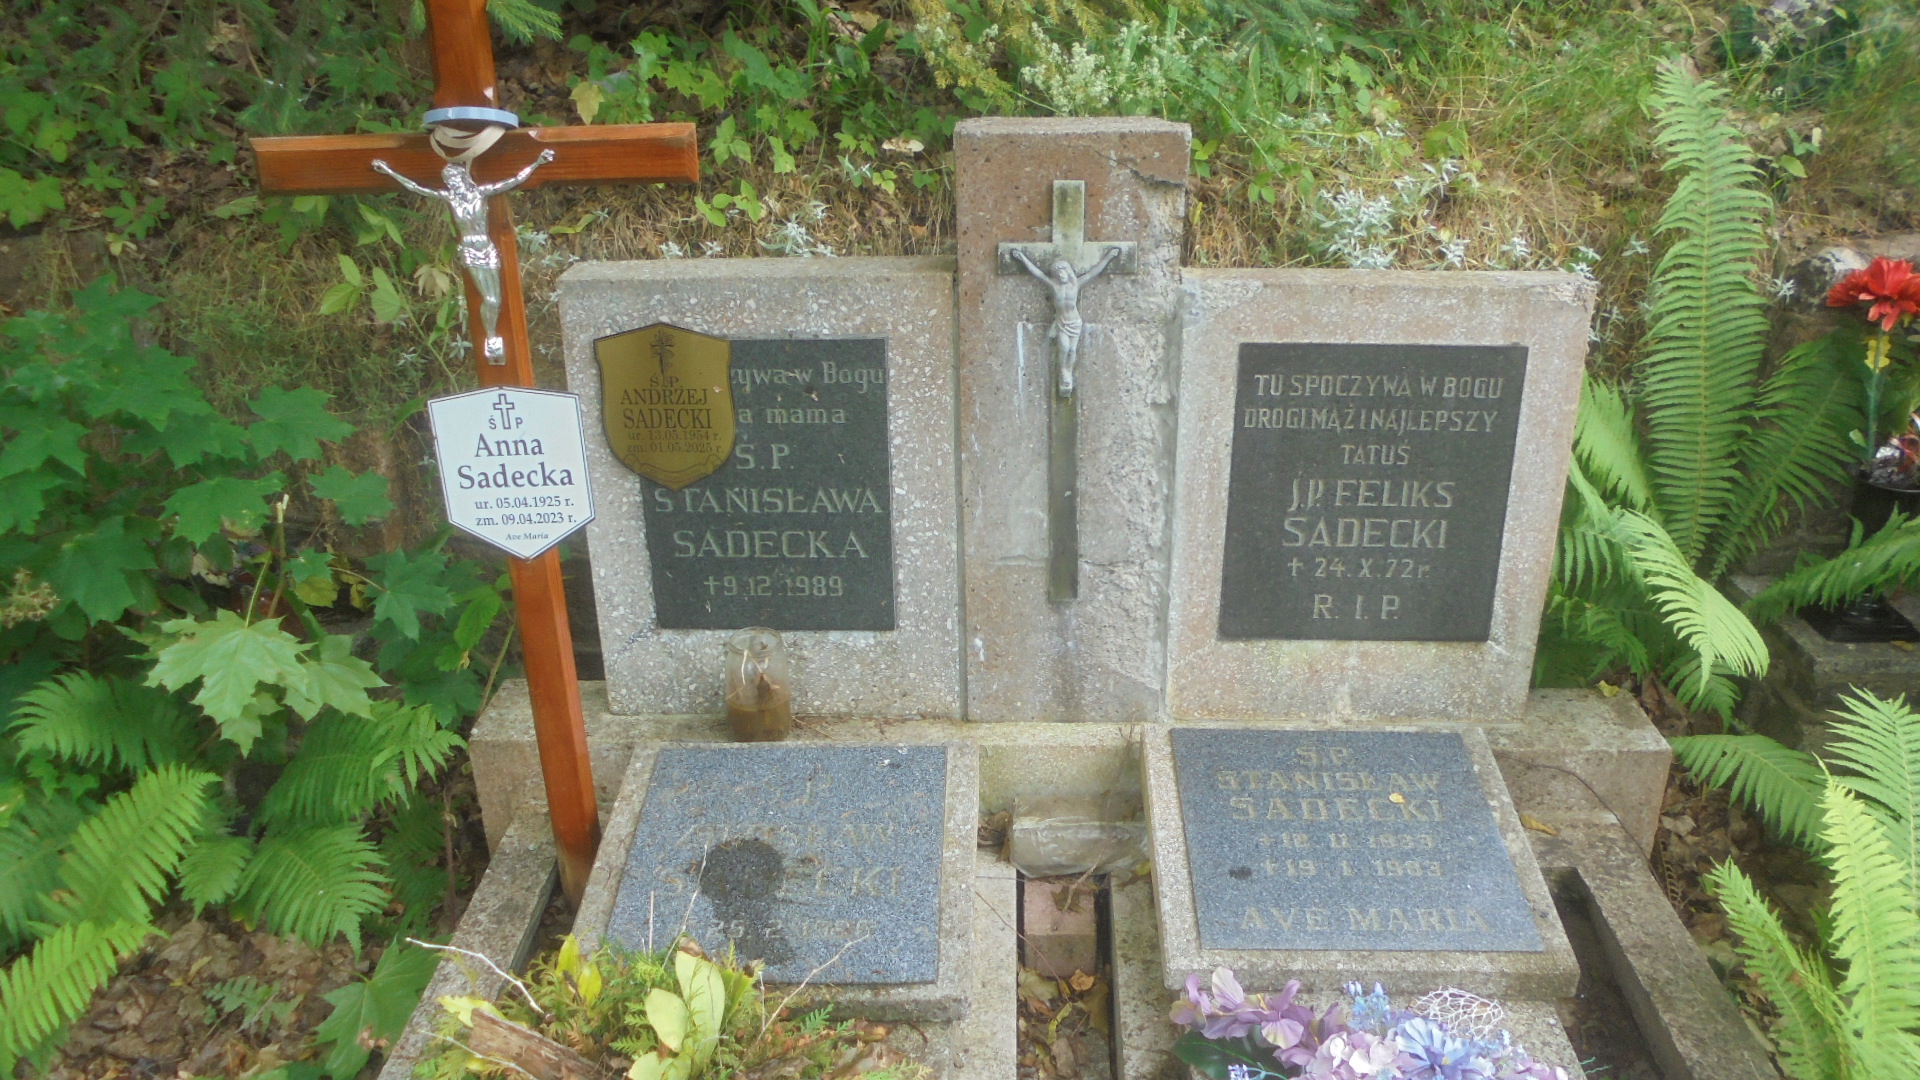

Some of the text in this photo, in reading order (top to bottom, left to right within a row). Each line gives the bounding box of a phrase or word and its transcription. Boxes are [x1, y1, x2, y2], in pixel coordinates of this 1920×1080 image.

[794, 368, 813, 383] w
[822, 361, 885, 394] Bogu
[1255, 374, 1503, 399] TU SPOCZYWA W BOGU
[620, 387, 708, 405] ANDRZEJ
[623, 408, 712, 429] SADECKI
[766, 408, 846, 424] mama
[1244, 407, 1307, 429] DROGI
[1359, 408, 1368, 430] I
[1370, 408, 1498, 436] NAJLEPSZY
[474, 433, 544, 457] Anna
[1340, 440, 1411, 465] TATUŚ
[458, 462, 575, 489] Sadecka
[475, 496, 575, 510] ur. 05.04.1925 r.
[654, 487, 884, 513] STANISŁAWA
[1334, 479, 1456, 508] FELIKS
[476, 512, 577, 526] zm. 09.04.2023 r.
[506, 532, 549, 541] Ave Maria
[673, 529, 869, 558] SADECKA
[1282, 516, 1448, 549] SADECKI
[1216, 770, 1441, 792] STANISŁAW
[1230, 797, 1444, 821] SADECKI
[1240, 906, 1491, 932] AVE MARIA
